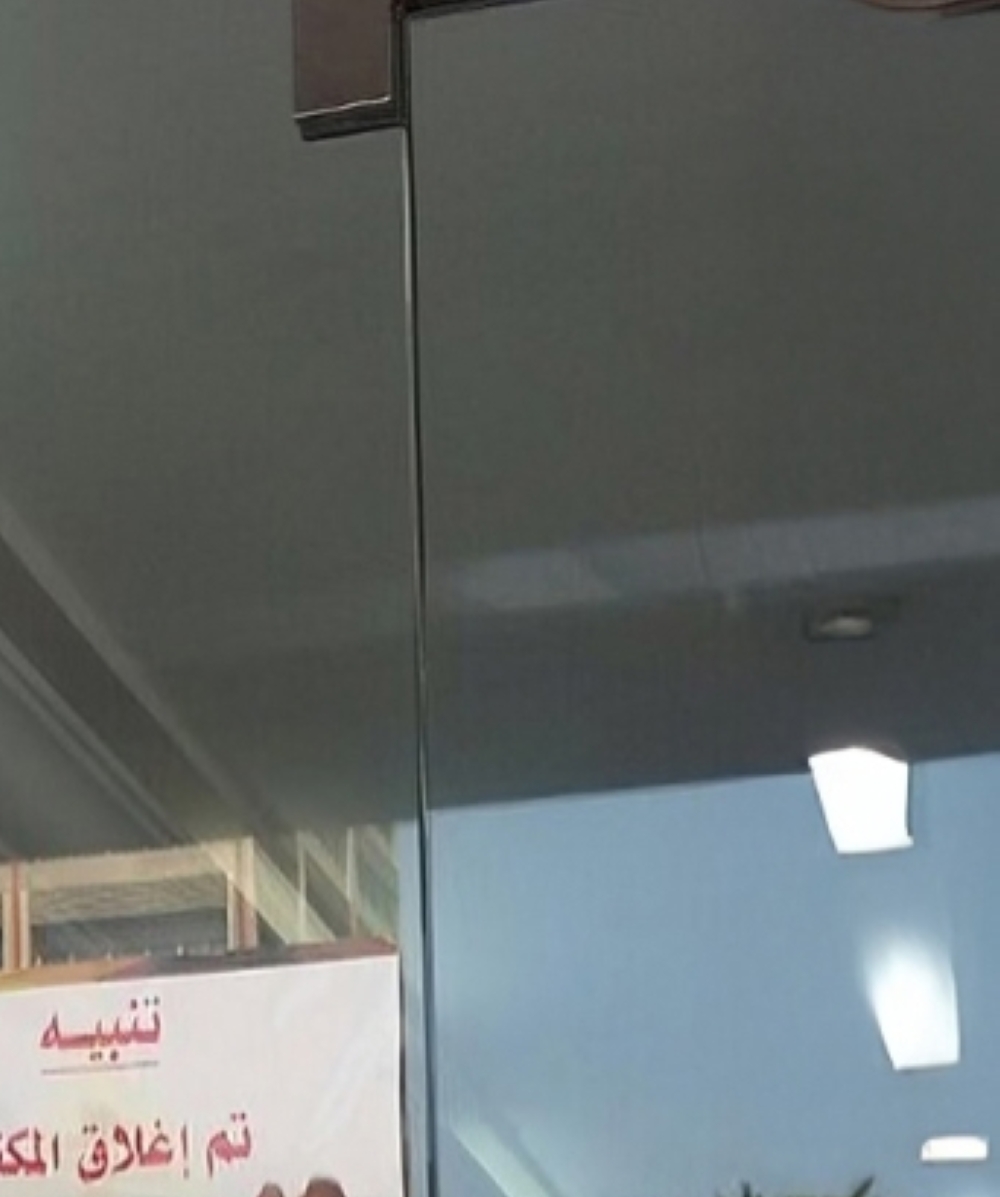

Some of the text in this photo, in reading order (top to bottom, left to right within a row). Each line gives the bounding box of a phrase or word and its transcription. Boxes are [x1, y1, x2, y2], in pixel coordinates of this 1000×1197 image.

[39, 997, 161, 1061] تنبيه
[77, 1119, 190, 1182] إغلاق
[205, 1113, 252, 1178] تم
